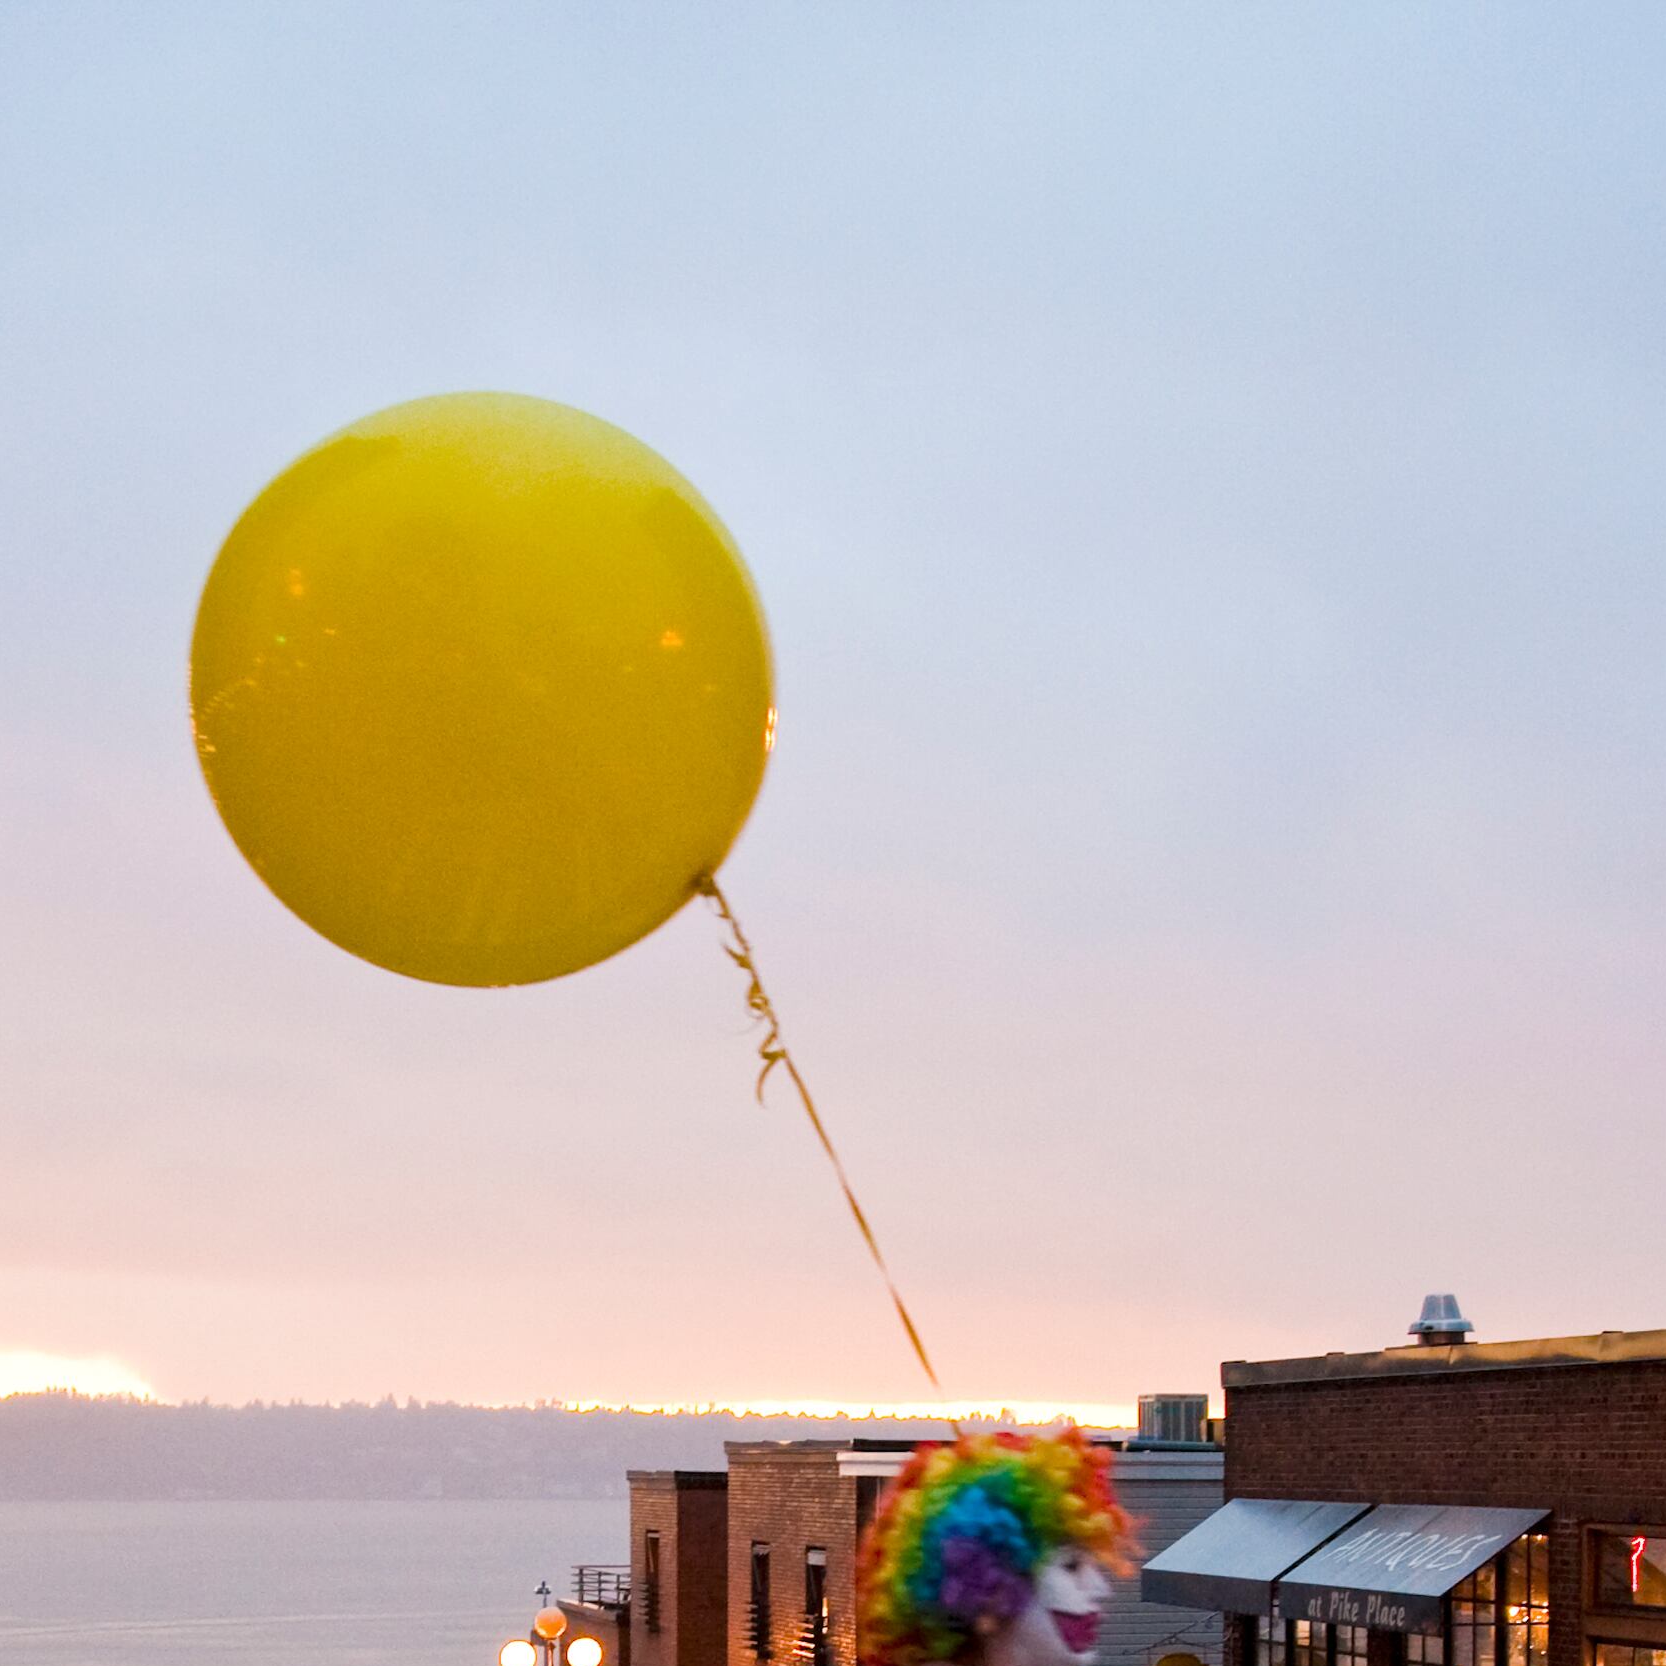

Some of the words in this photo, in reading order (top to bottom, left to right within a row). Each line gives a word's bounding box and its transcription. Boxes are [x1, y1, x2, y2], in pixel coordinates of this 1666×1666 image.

[1319, 1528, 1502, 1571] ANTIQUES
[1307, 1597, 1322, 1617] at
[1329, 1592, 1359, 1622] Pike
[1366, 1595, 1406, 1627] Place
